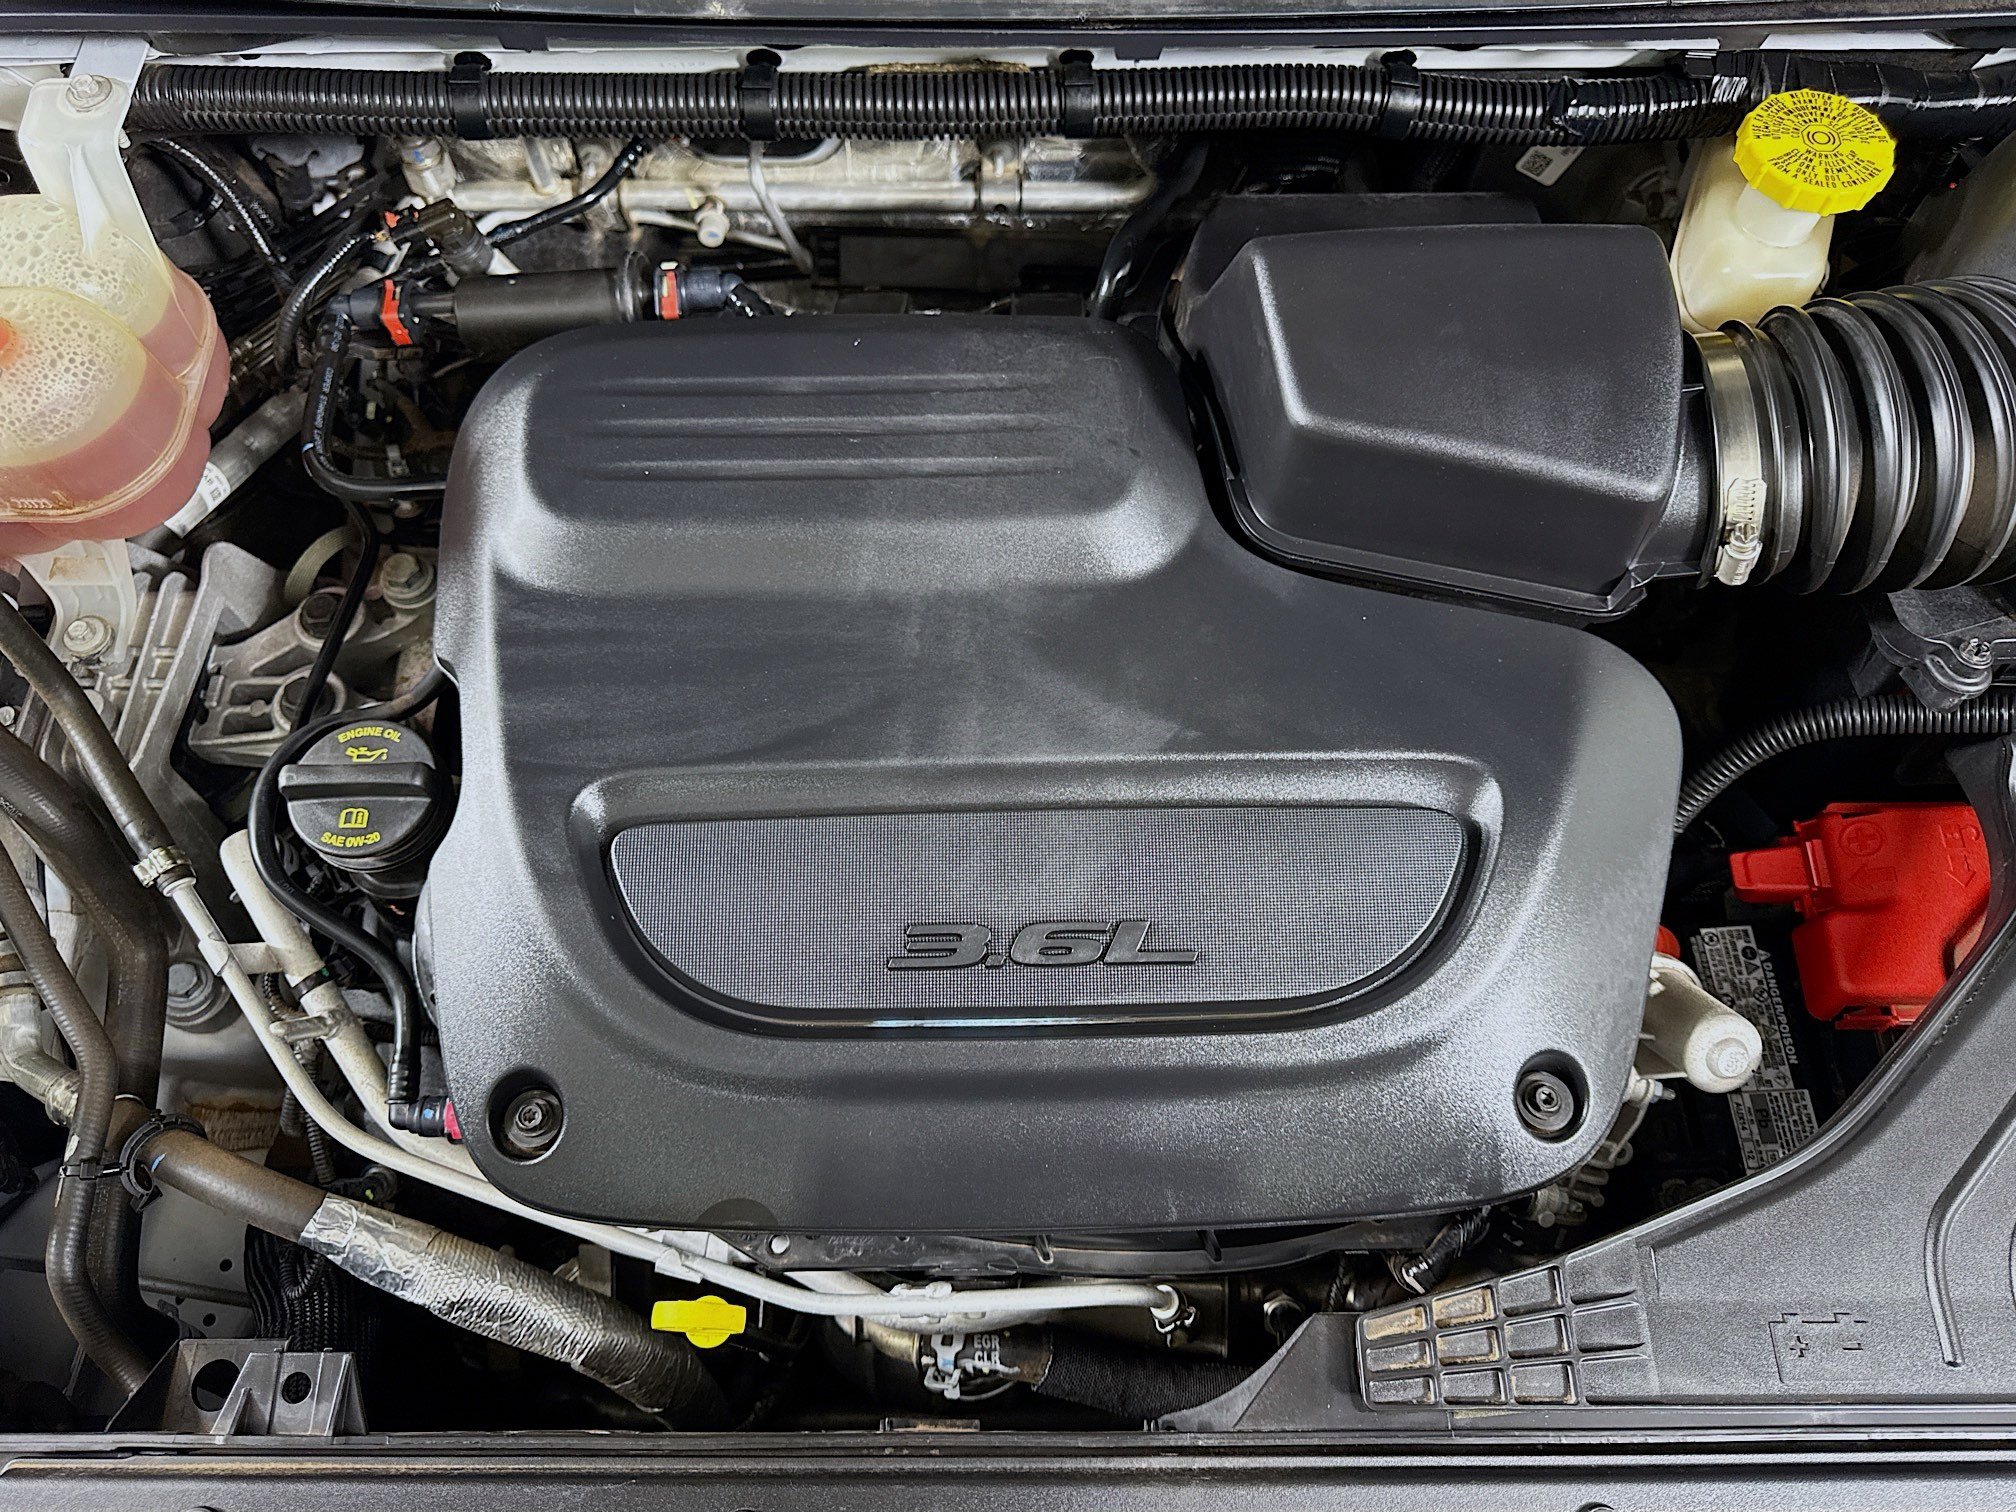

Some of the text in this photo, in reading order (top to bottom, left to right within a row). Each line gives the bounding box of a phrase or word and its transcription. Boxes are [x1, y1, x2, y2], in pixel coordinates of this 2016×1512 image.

[1789, 92, 1832, 100] NETTOYER
[1791, 148, 1814, 163] CLEAN
[1819, 158, 1846, 167] FILLER
[1805, 148, 1844, 159] WARNING
[1796, 168, 1818, 179] ONLY
[1803, 177, 1837, 188] SEALED
[337, 726, 402, 744] ENGINE OIL
[320, 831, 381, 848] SAE 0W-20
[887, 919, 1199, 969] 3.6L
[1763, 962, 1798, 1064] DANGER/POISON
[973, 1334, 1000, 1349] EGR
